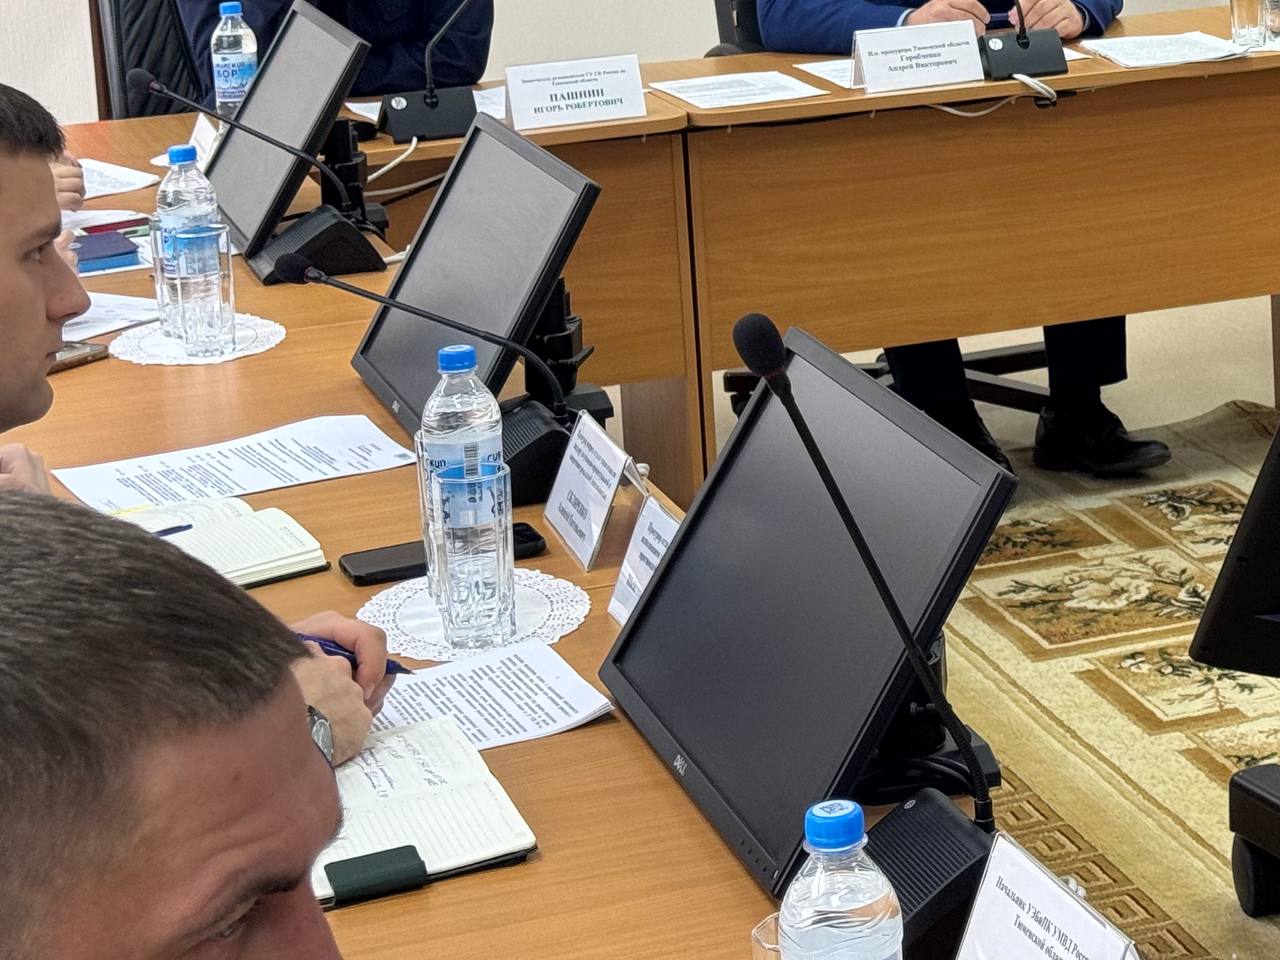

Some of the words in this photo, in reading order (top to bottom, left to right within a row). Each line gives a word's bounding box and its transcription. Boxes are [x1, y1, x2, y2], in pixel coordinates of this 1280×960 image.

[550, 88, 604, 102] ПАШНИН
[534, 105, 563, 114] ИГОРЬ
[565, 98, 623, 110] РОБЕРТОВИЧ
[1014, 914, 1045, 950] Тюменской
